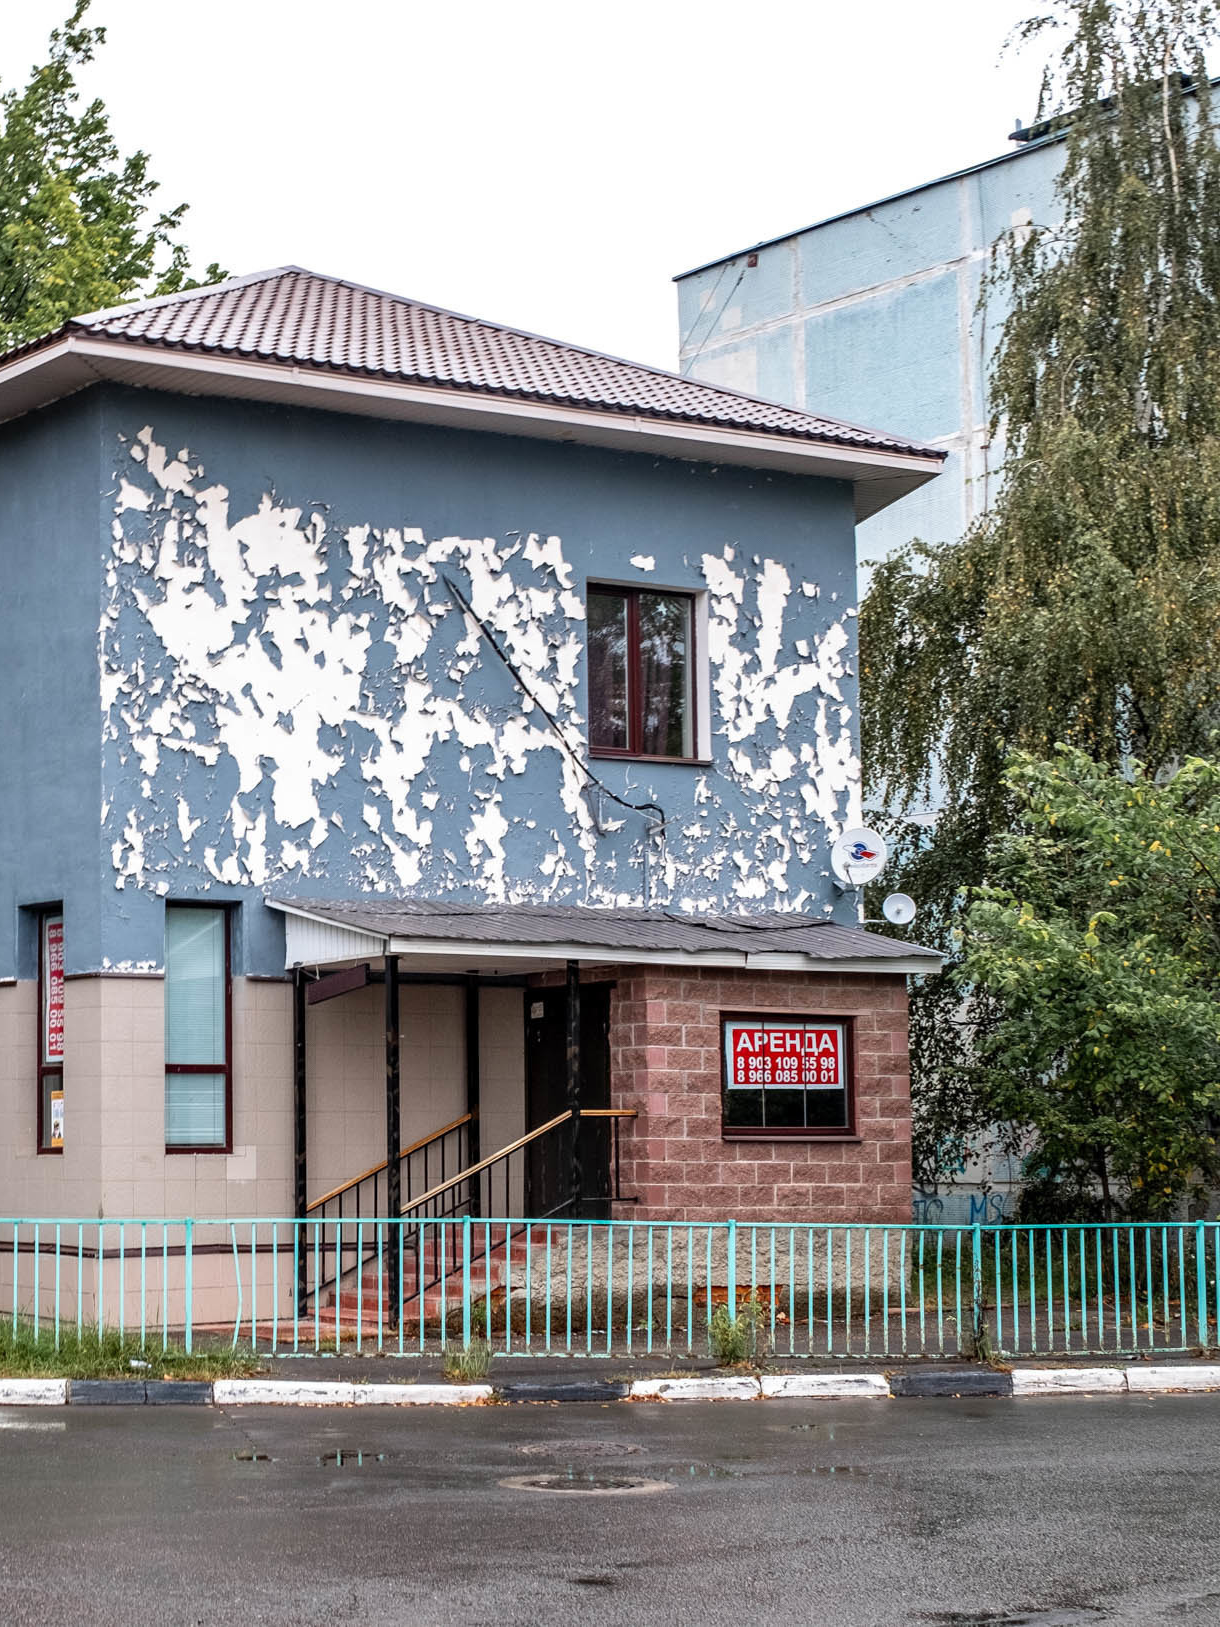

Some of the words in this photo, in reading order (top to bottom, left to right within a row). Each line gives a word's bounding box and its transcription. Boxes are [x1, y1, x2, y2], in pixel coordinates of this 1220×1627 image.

[50, 1009, 57, 1028] 00
[49, 1033, 57, 1050] 01
[736, 1032, 835, 1056] АРЕНДА
[737, 1056, 745, 1069] 8
[748, 1056, 772, 1069] 903
[775, 1056, 798, 1070] 109
[802, 1057, 817, 1069] 55
[820, 1057, 836, 1069] 98
[737, 1070, 745, 1083] 8
[748, 1070, 772, 1083] 966
[775, 1070, 798, 1083] 085
[802, 1070, 817, 1083] 00
[820, 1070, 835, 1083] 01
